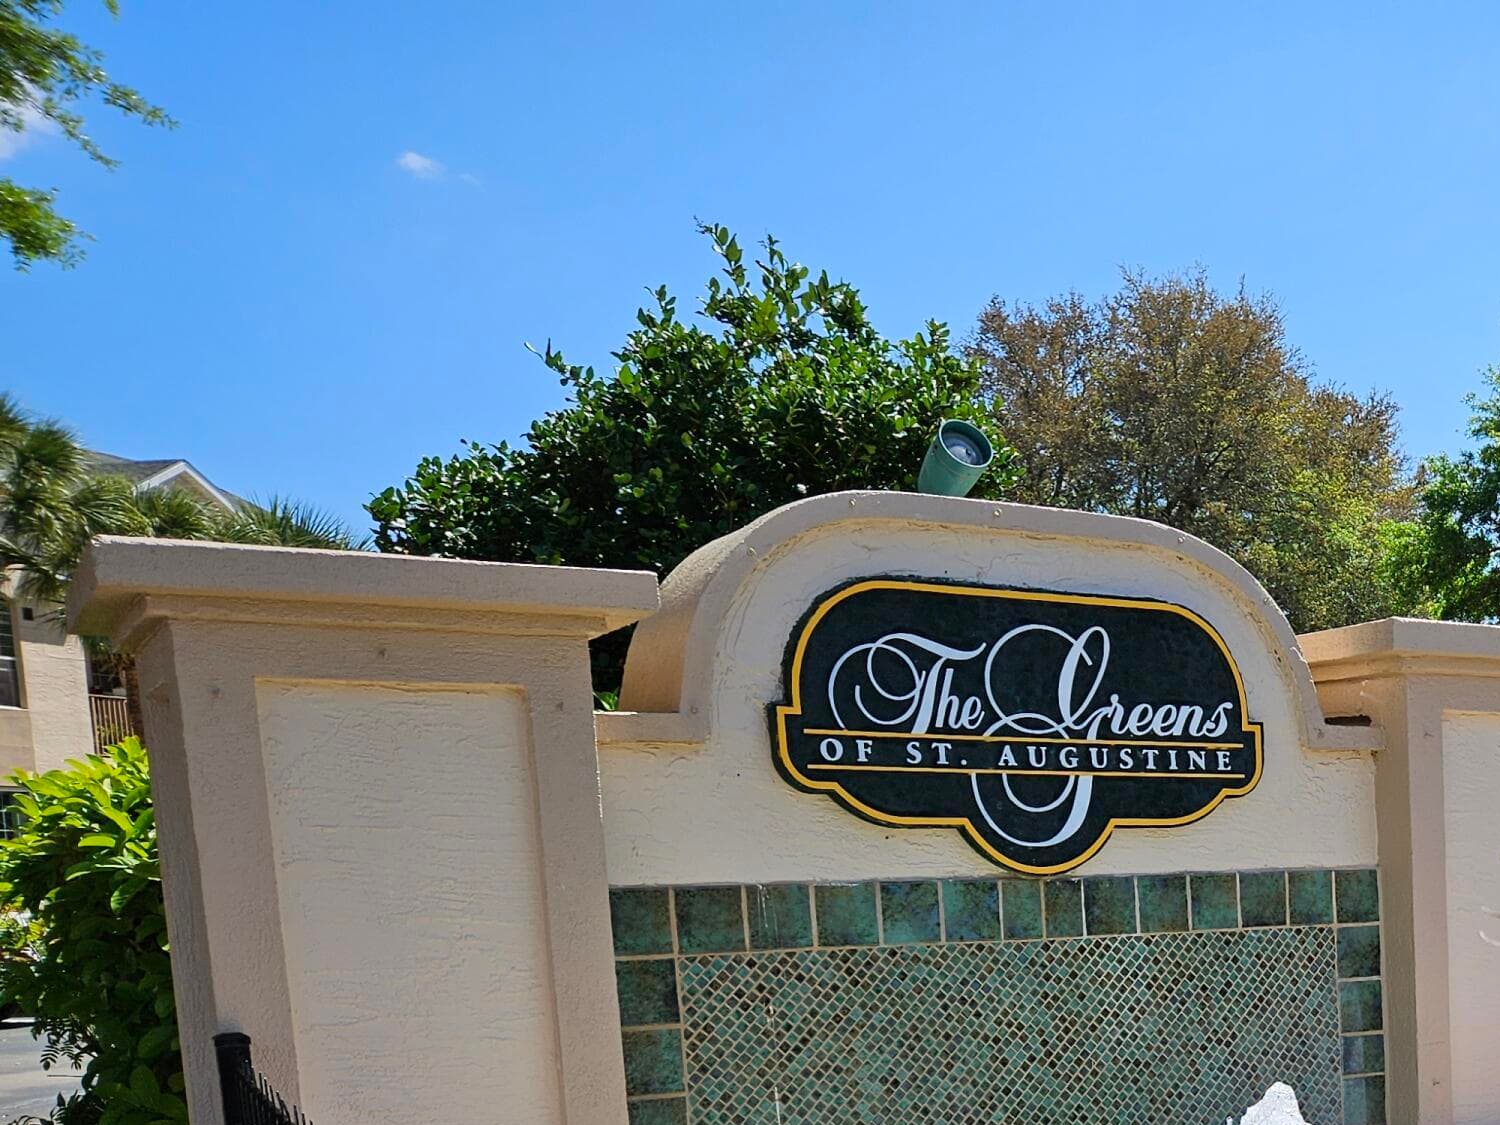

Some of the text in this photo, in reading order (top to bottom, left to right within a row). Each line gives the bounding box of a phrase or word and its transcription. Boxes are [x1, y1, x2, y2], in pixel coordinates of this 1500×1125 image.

[828, 632, 987, 735] The
[819, 738, 1233, 772] OF ST. AUGUSTINE
